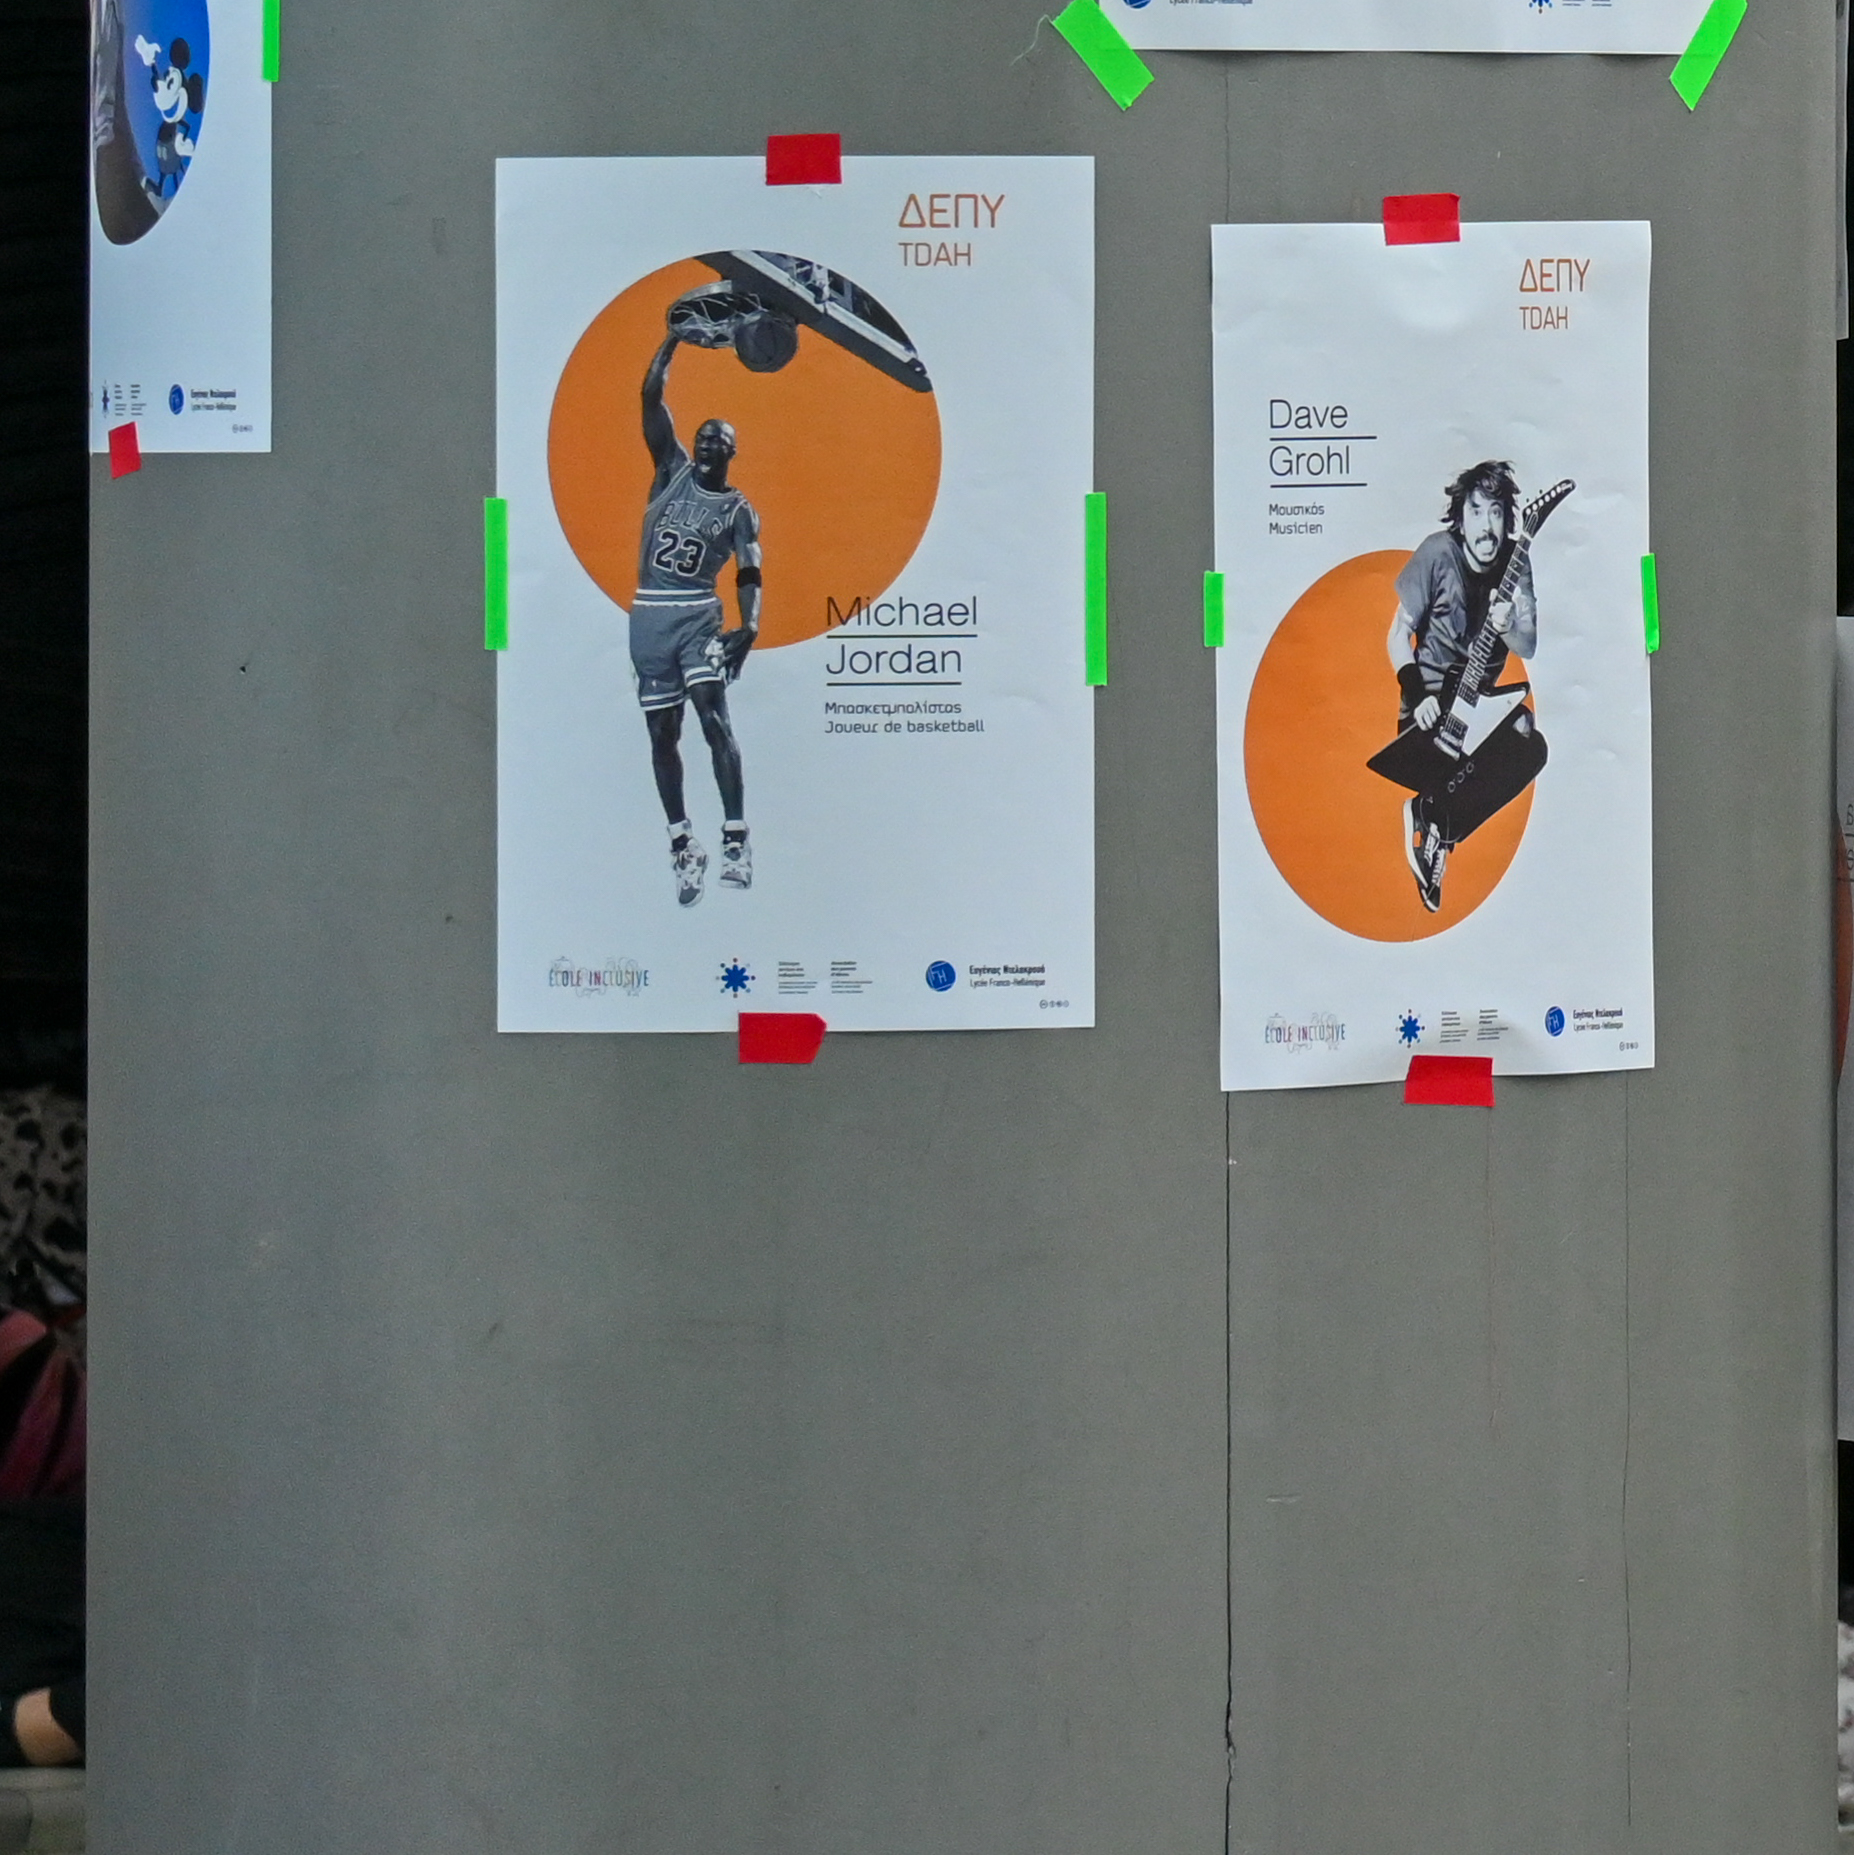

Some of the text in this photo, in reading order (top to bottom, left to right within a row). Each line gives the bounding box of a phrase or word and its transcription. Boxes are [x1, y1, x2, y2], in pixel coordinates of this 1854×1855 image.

[899, 193, 1005, 228] ΔΕΠΥ
[898, 242, 971, 266] TDAH
[1519, 258, 1590, 292] ΔΕΠΥ
[1519, 306, 1568, 330] TDAH
[1270, 399, 1348, 429] Dave
[1270, 445, 1350, 477] Grohl
[1269, 522, 1323, 534] Musicien
[653, 529, 707, 577] 23
[826, 595, 978, 627] Michael
[826, 643, 962, 675] Jordan
[824, 719, 985, 734] Joueur de basketball
